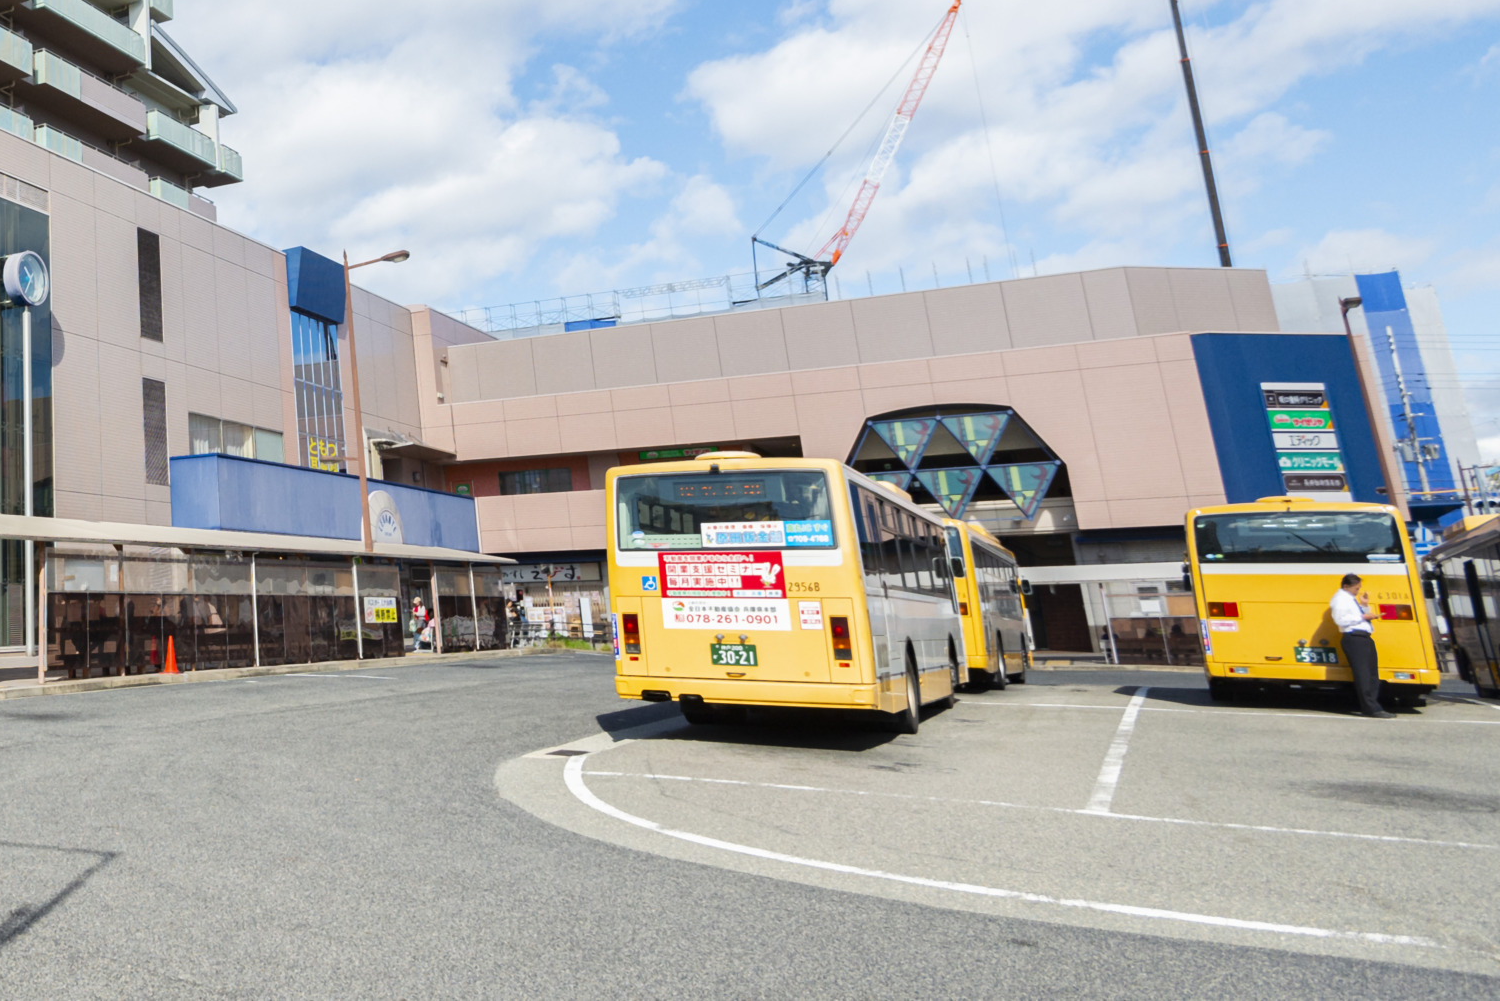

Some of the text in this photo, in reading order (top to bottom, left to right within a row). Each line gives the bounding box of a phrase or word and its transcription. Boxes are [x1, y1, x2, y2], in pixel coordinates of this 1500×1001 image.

[1292, 457, 1340, 468] クリニックモール
[668, 564, 763, 574] 開業支援セミナー
[686, 614, 778, 624] 078-261-0901
[718, 650, 754, 665] 30-21
[1301, 651, 1336, 663] 59-18
